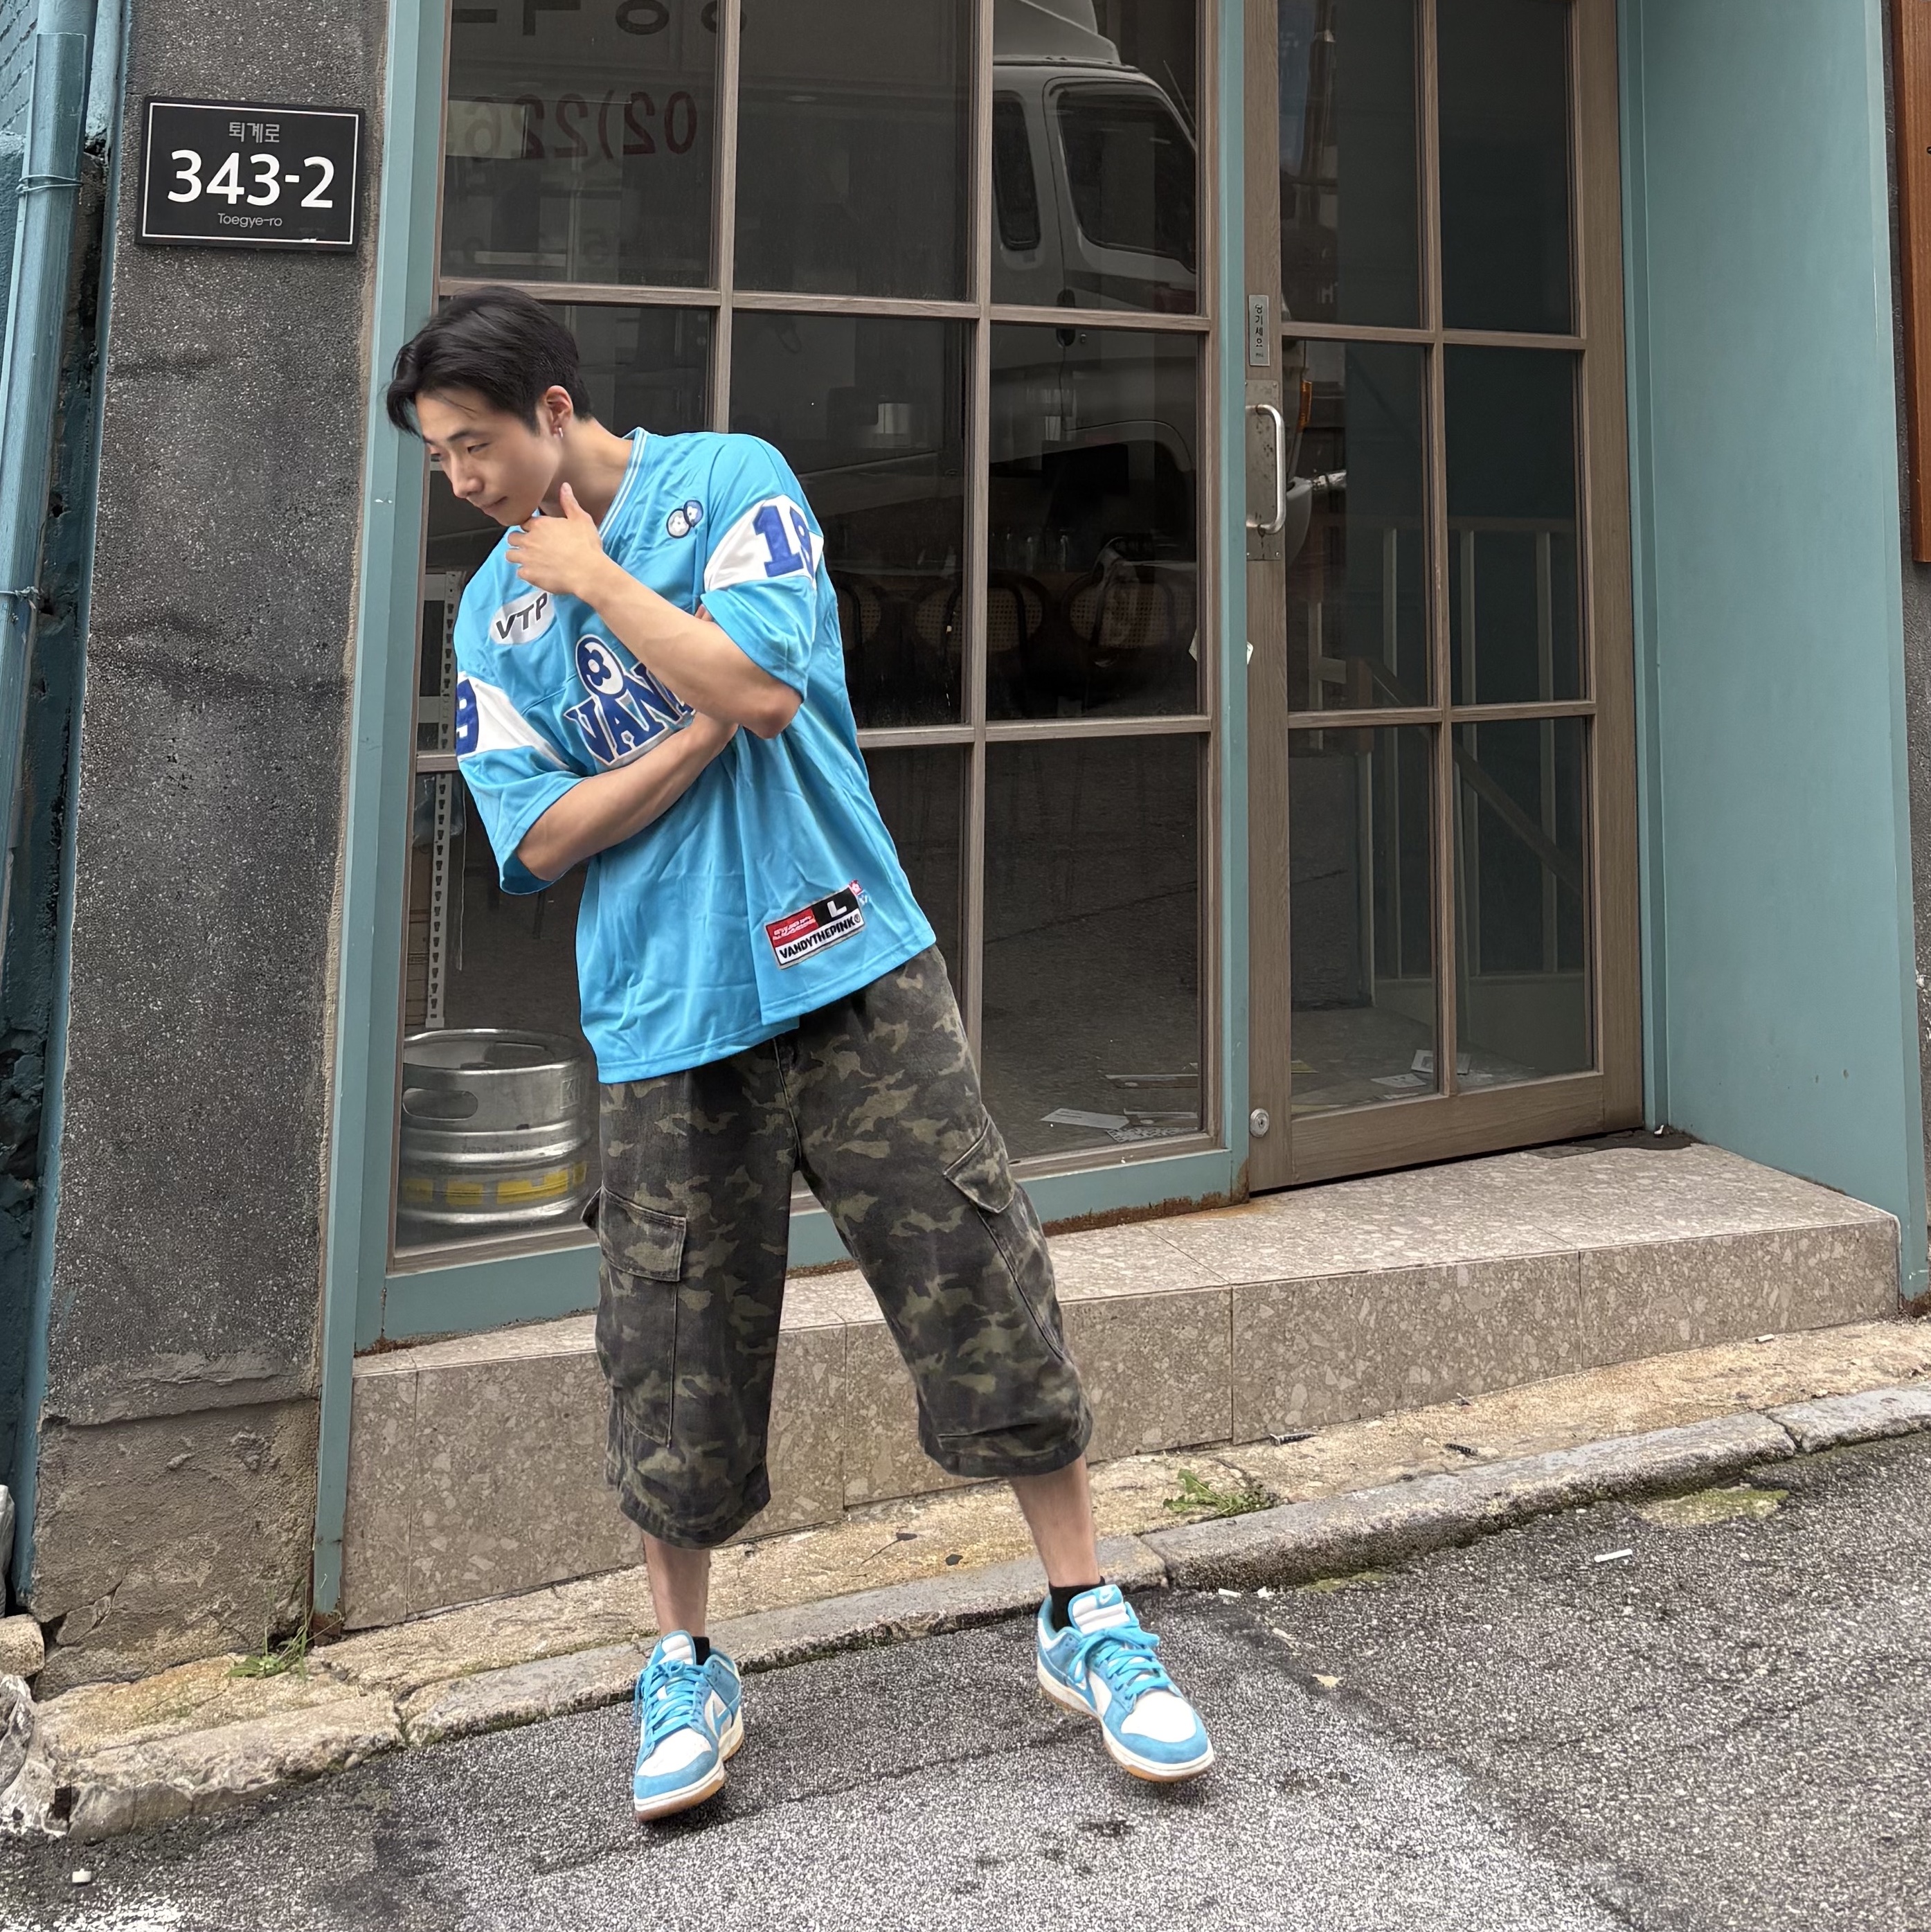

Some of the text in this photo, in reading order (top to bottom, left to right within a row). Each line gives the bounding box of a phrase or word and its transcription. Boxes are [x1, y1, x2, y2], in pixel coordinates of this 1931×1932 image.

[229, 121, 280, 143] 퇴계로
[168, 149, 335, 208] 343-2
[217, 213, 282, 228] Toegye-ro
[496, 592, 548, 639] VTP
[564, 661, 696, 766] VAN
[827, 900, 847, 918] L
